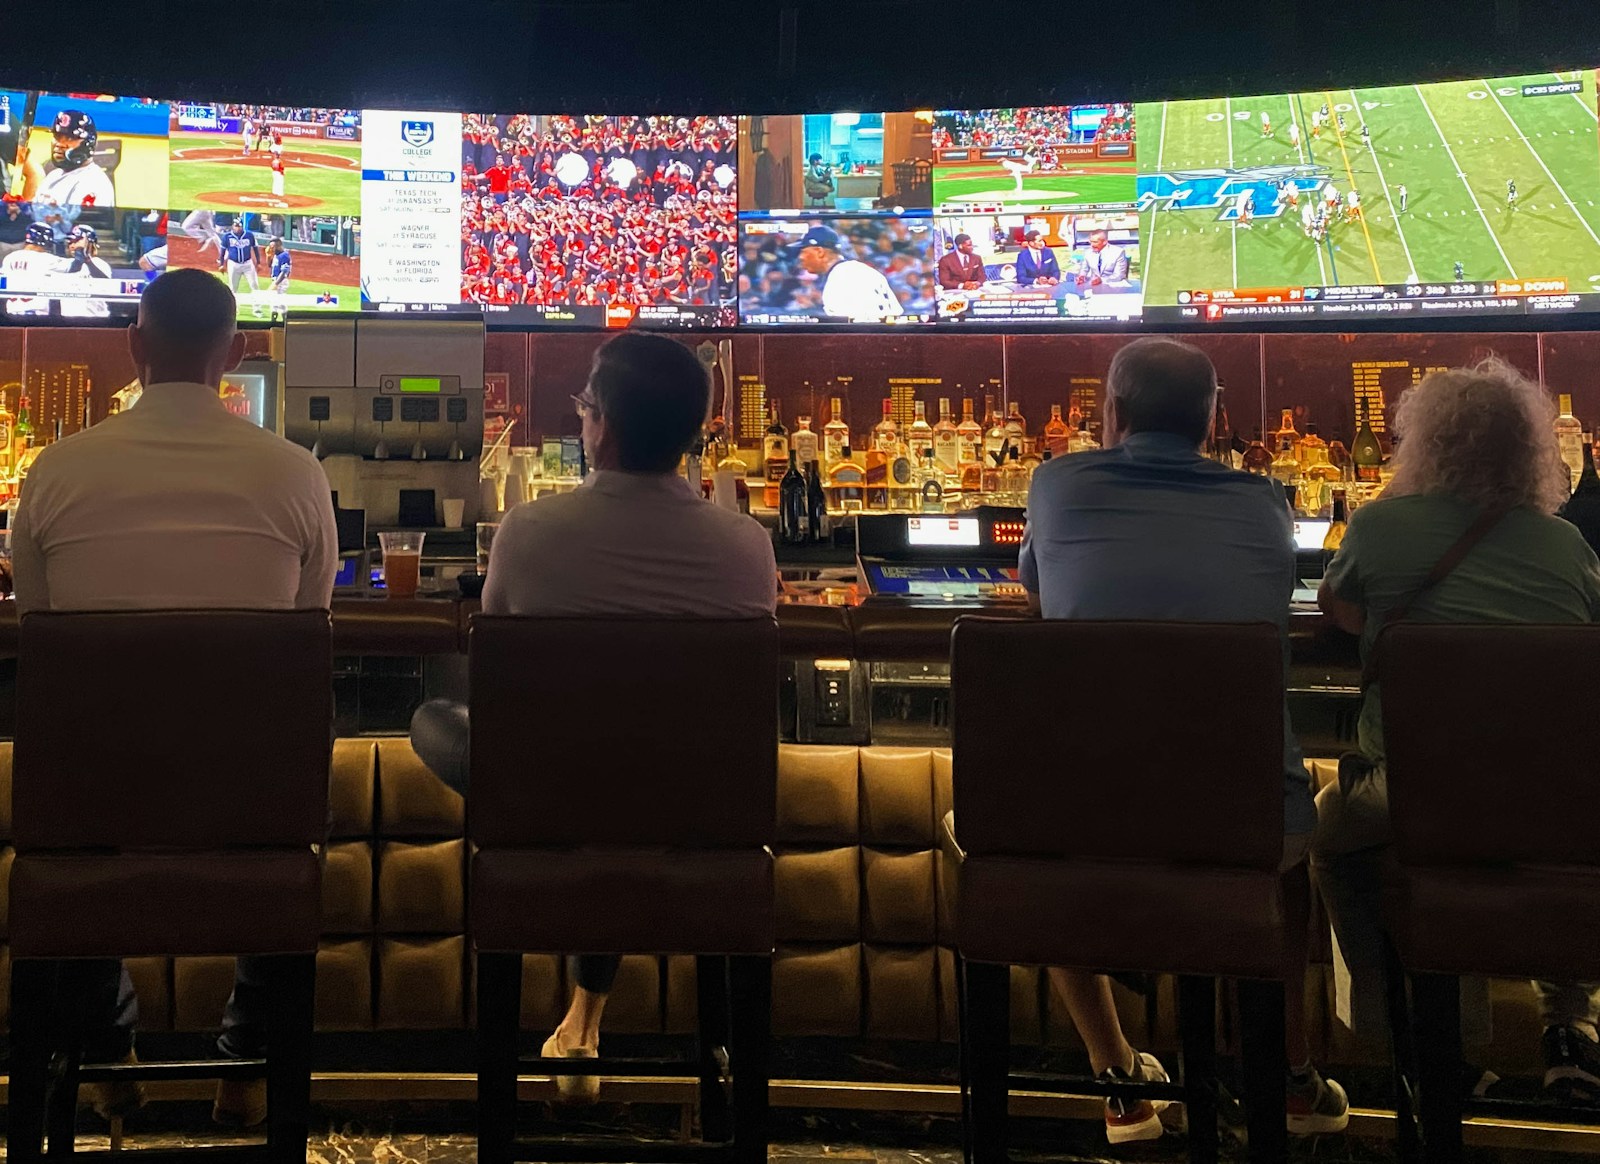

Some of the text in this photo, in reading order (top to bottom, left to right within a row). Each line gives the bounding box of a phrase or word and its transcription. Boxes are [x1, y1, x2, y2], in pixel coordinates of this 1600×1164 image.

[1548, 83, 1580, 92] SPORTS
[407, 171, 451, 182] WEEKEND
[395, 189, 437, 197] TEXAS TECH
[401, 232, 437, 240] SYRACUSE
[1324, 286, 1359, 295] MIDDLE
[1406, 286, 1422, 296] 20
[1524, 281, 1565, 292] DOWN
